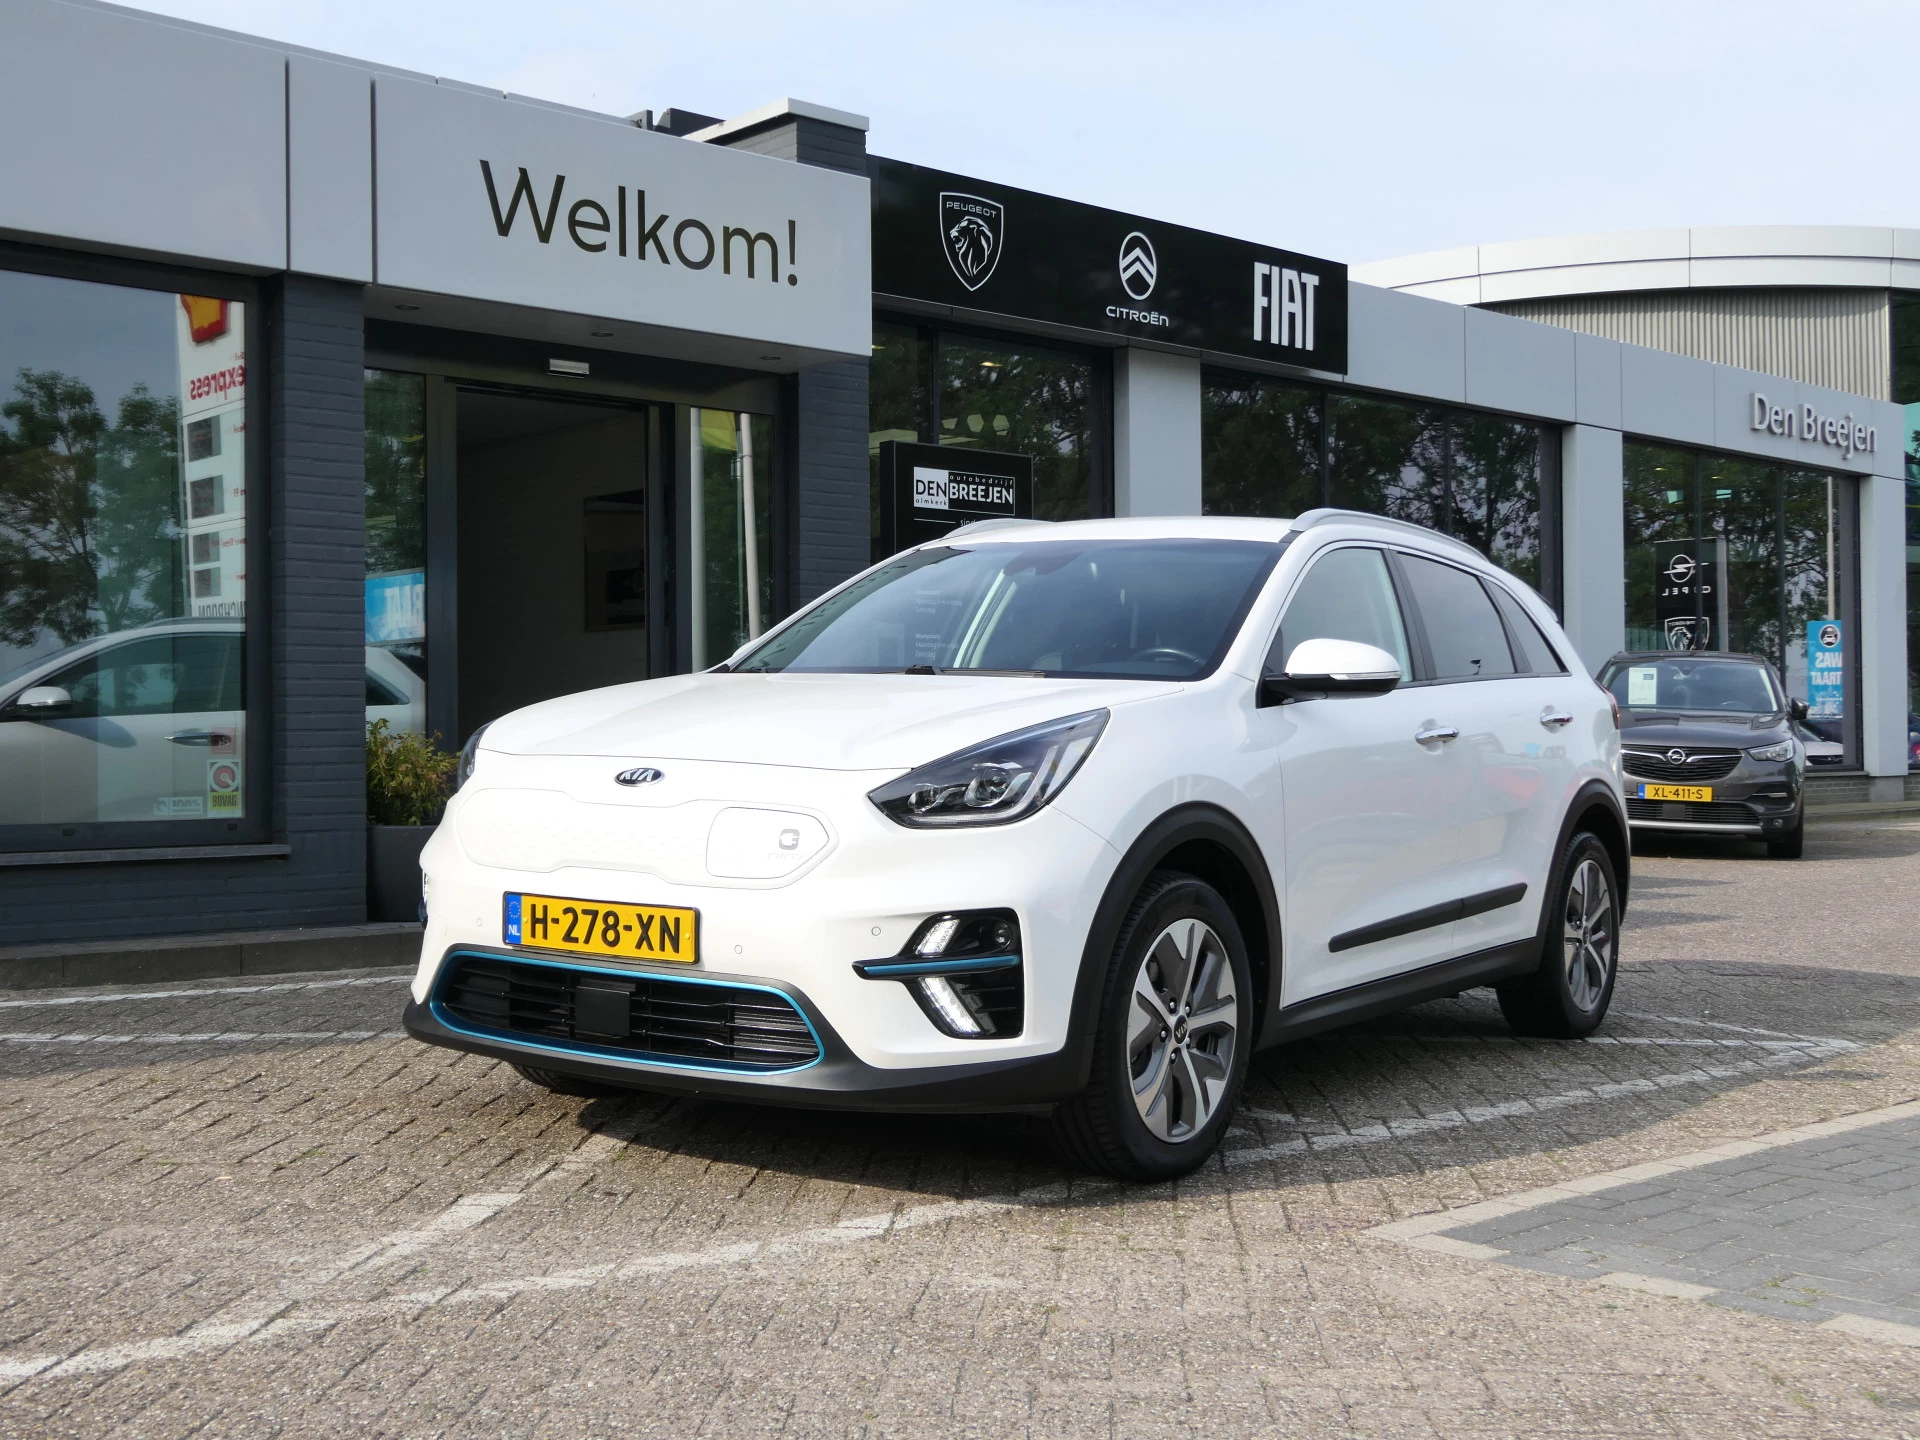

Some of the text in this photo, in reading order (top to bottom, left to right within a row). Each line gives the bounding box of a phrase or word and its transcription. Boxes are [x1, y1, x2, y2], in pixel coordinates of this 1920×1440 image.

[946, 201, 997, 218] PEUGEOT
[479, 159, 798, 287] Welkom!
[1253, 261, 1320, 351] FIAT
[1750, 392, 1878, 460] Den Breejen
[949, 475, 1013, 487] autobedrijf
[915, 479, 1013, 505] DEN BREEJEN
[915, 498, 947, 506] almkerk
[619, 768, 655, 782] KIA
[212, 794, 237, 807] BOVAG
[1653, 786, 1703, 800] XL-411-S
[508, 924, 521, 936] NL
[530, 903, 681, 954] H-278-XN
